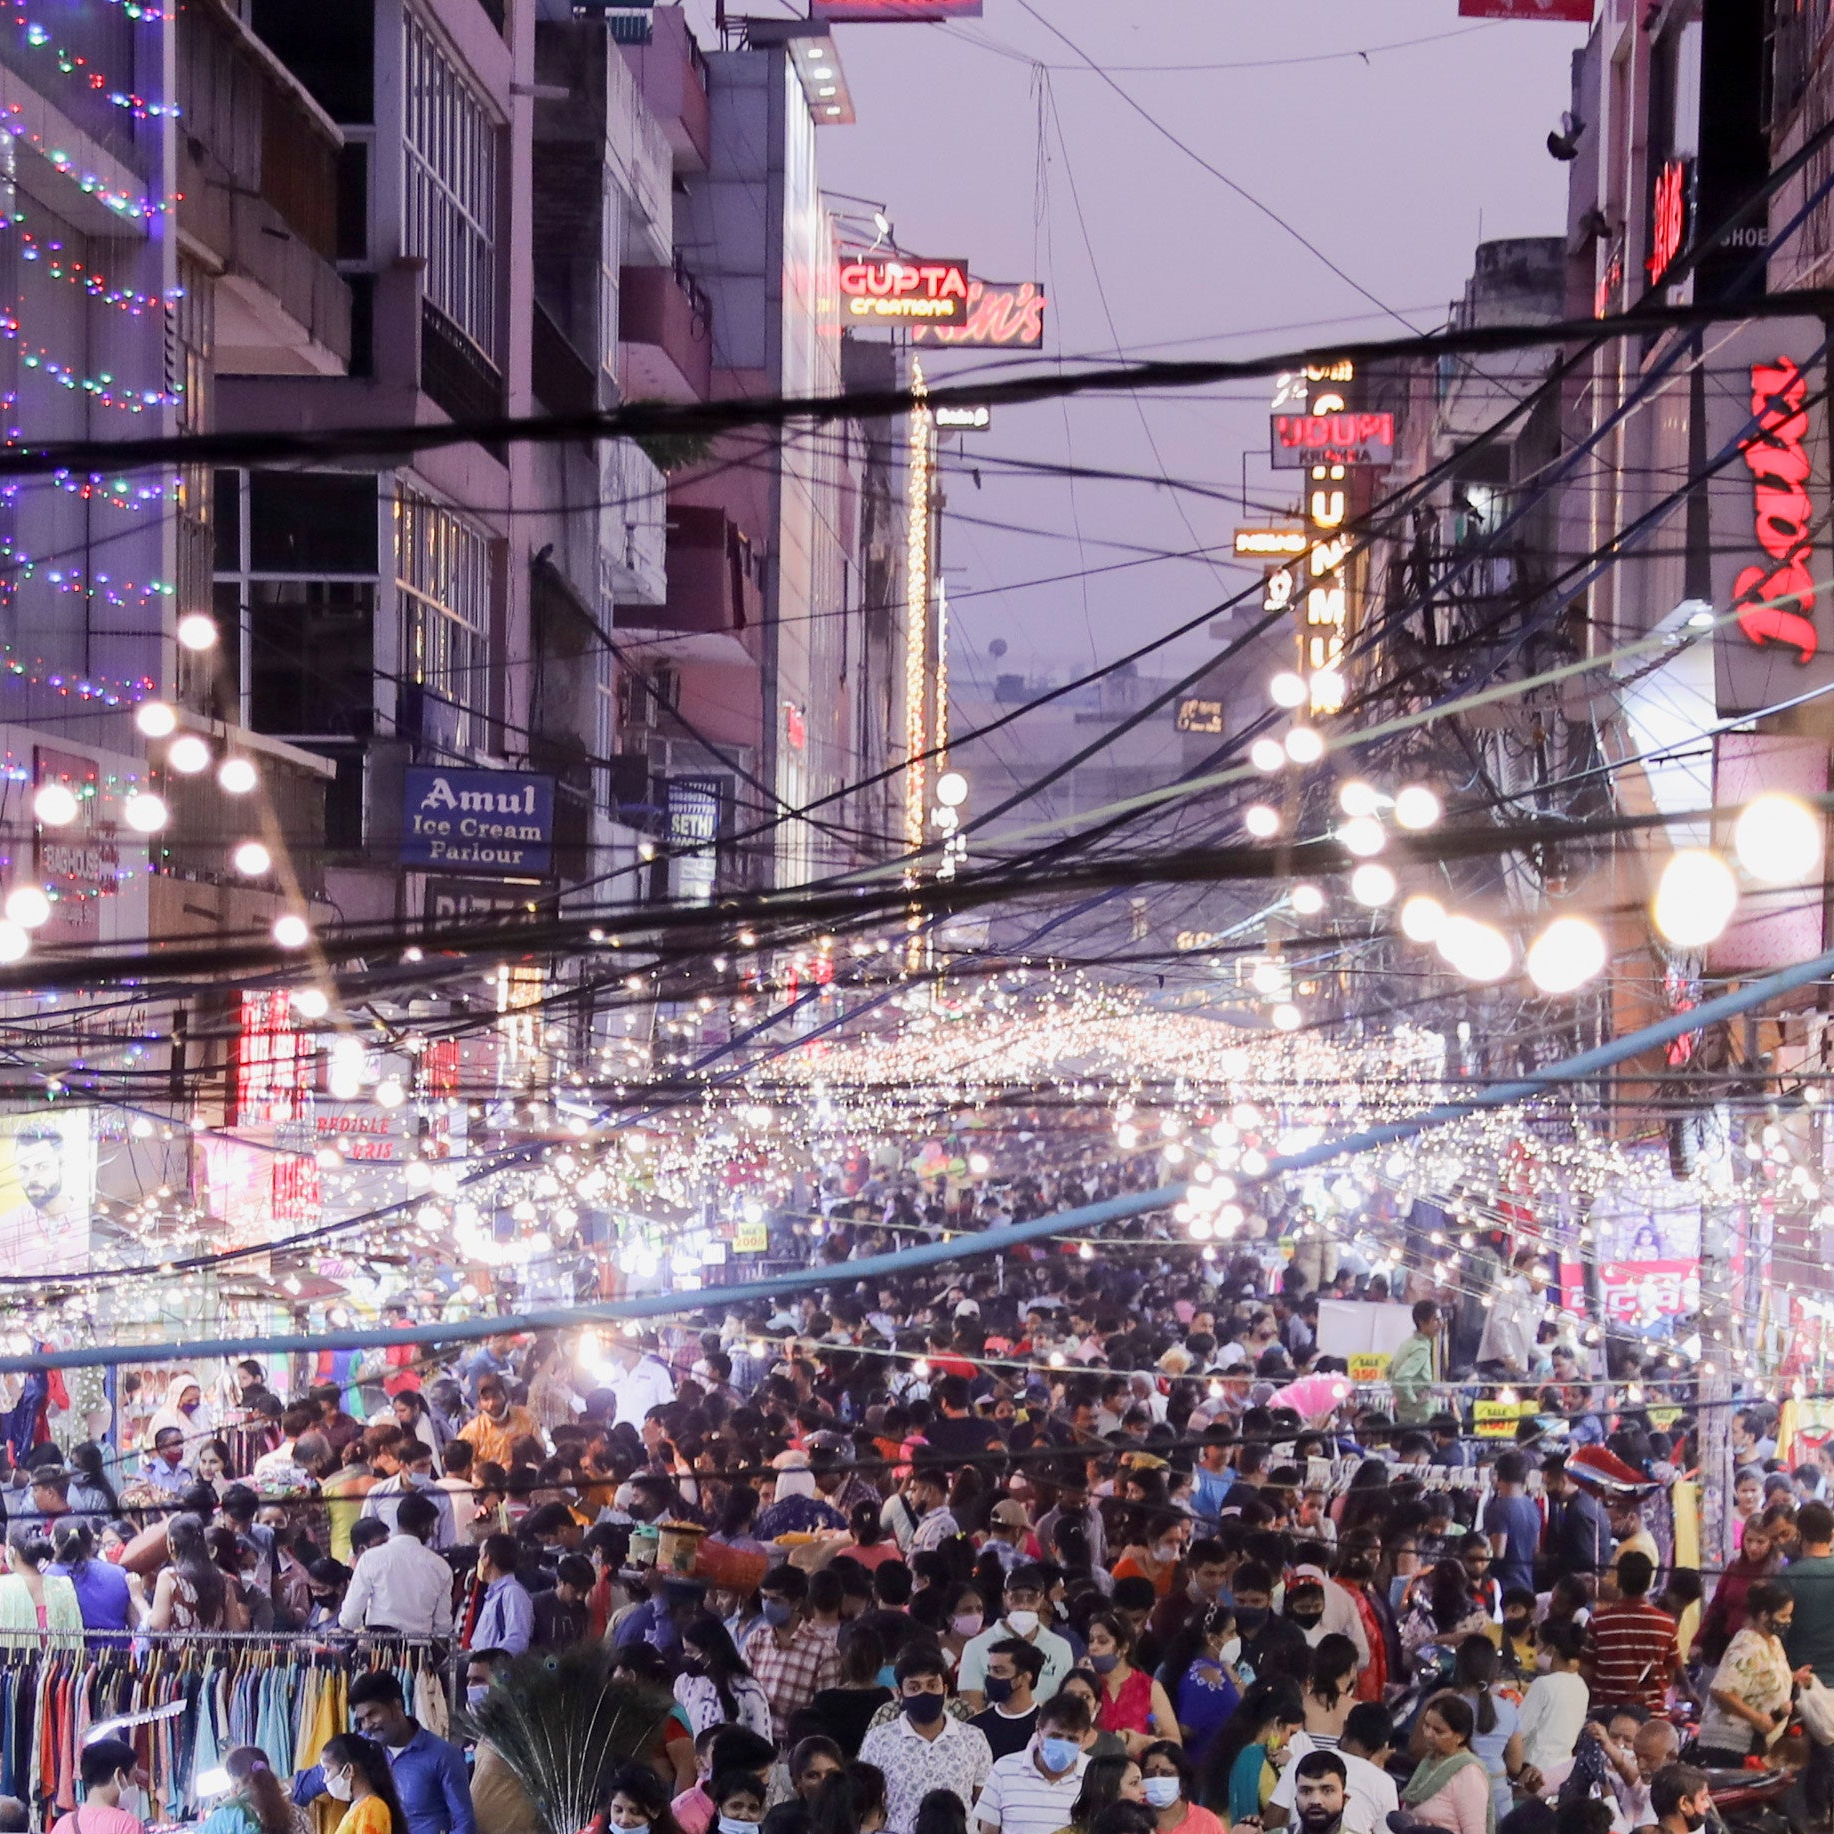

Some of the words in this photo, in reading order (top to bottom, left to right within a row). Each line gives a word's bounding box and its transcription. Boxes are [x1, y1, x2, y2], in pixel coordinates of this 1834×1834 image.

[840, 265, 966, 297] GUPTA
[421, 777, 536, 815] Amul
[413, 814, 450, 834] Ice
[460, 818, 542, 841] Cream
[671, 813, 714, 837] SETHI
[429, 840, 524, 864] Parlour
